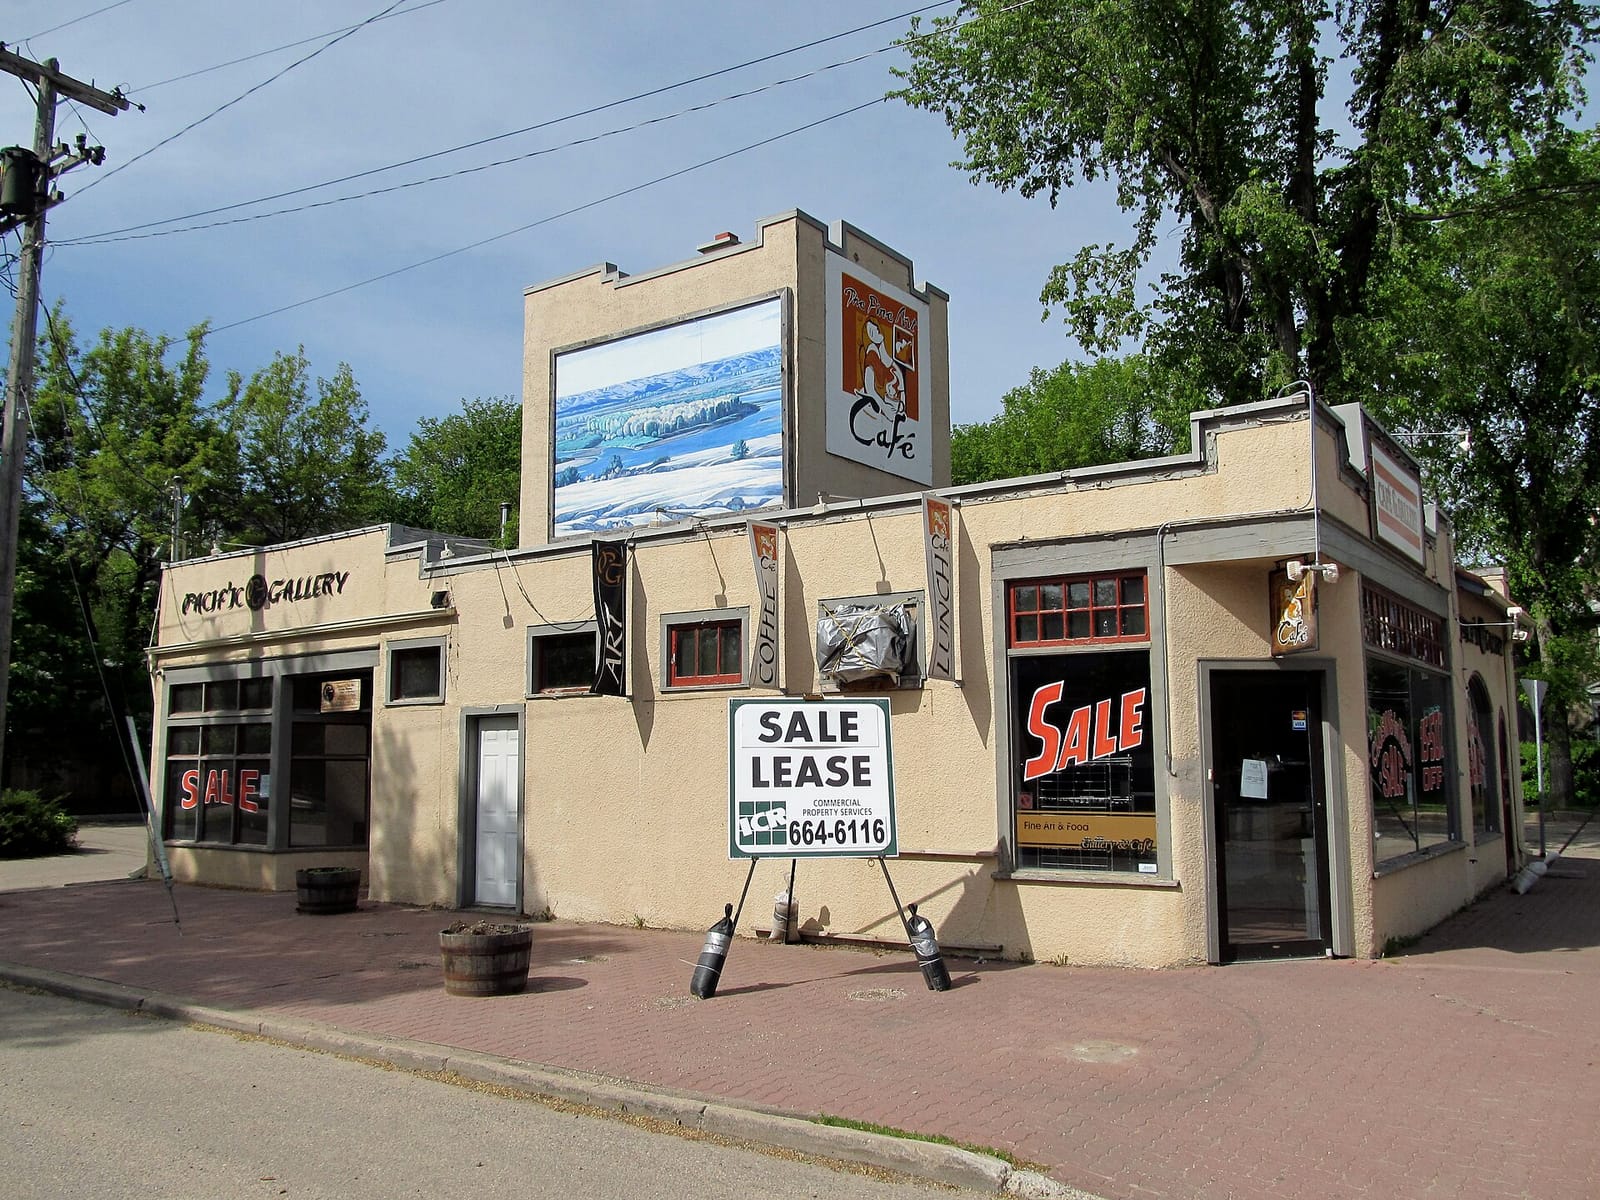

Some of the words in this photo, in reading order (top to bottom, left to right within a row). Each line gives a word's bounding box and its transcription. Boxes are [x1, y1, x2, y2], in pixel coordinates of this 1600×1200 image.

[849, 391, 916, 460] Café
[267, 571, 350, 605] GALLERY
[934, 553, 950, 677] LUNCH
[603, 601, 623, 685] ART
[759, 580, 776, 684] COFFEE
[1277, 620, 1308, 645] Café
[758, 710, 859, 743] SALE
[1024, 680, 1146, 782] SALE
[752, 755, 872, 788] LEASE
[181, 769, 259, 814] SALE
[813, 799, 861, 807] COMMERCIAL
[802, 808, 838, 817] PROPERTY
[840, 807, 873, 816] SERVICES
[1023, 821, 1041, 830] Fine
[789, 818, 885, 846] 664-6116
